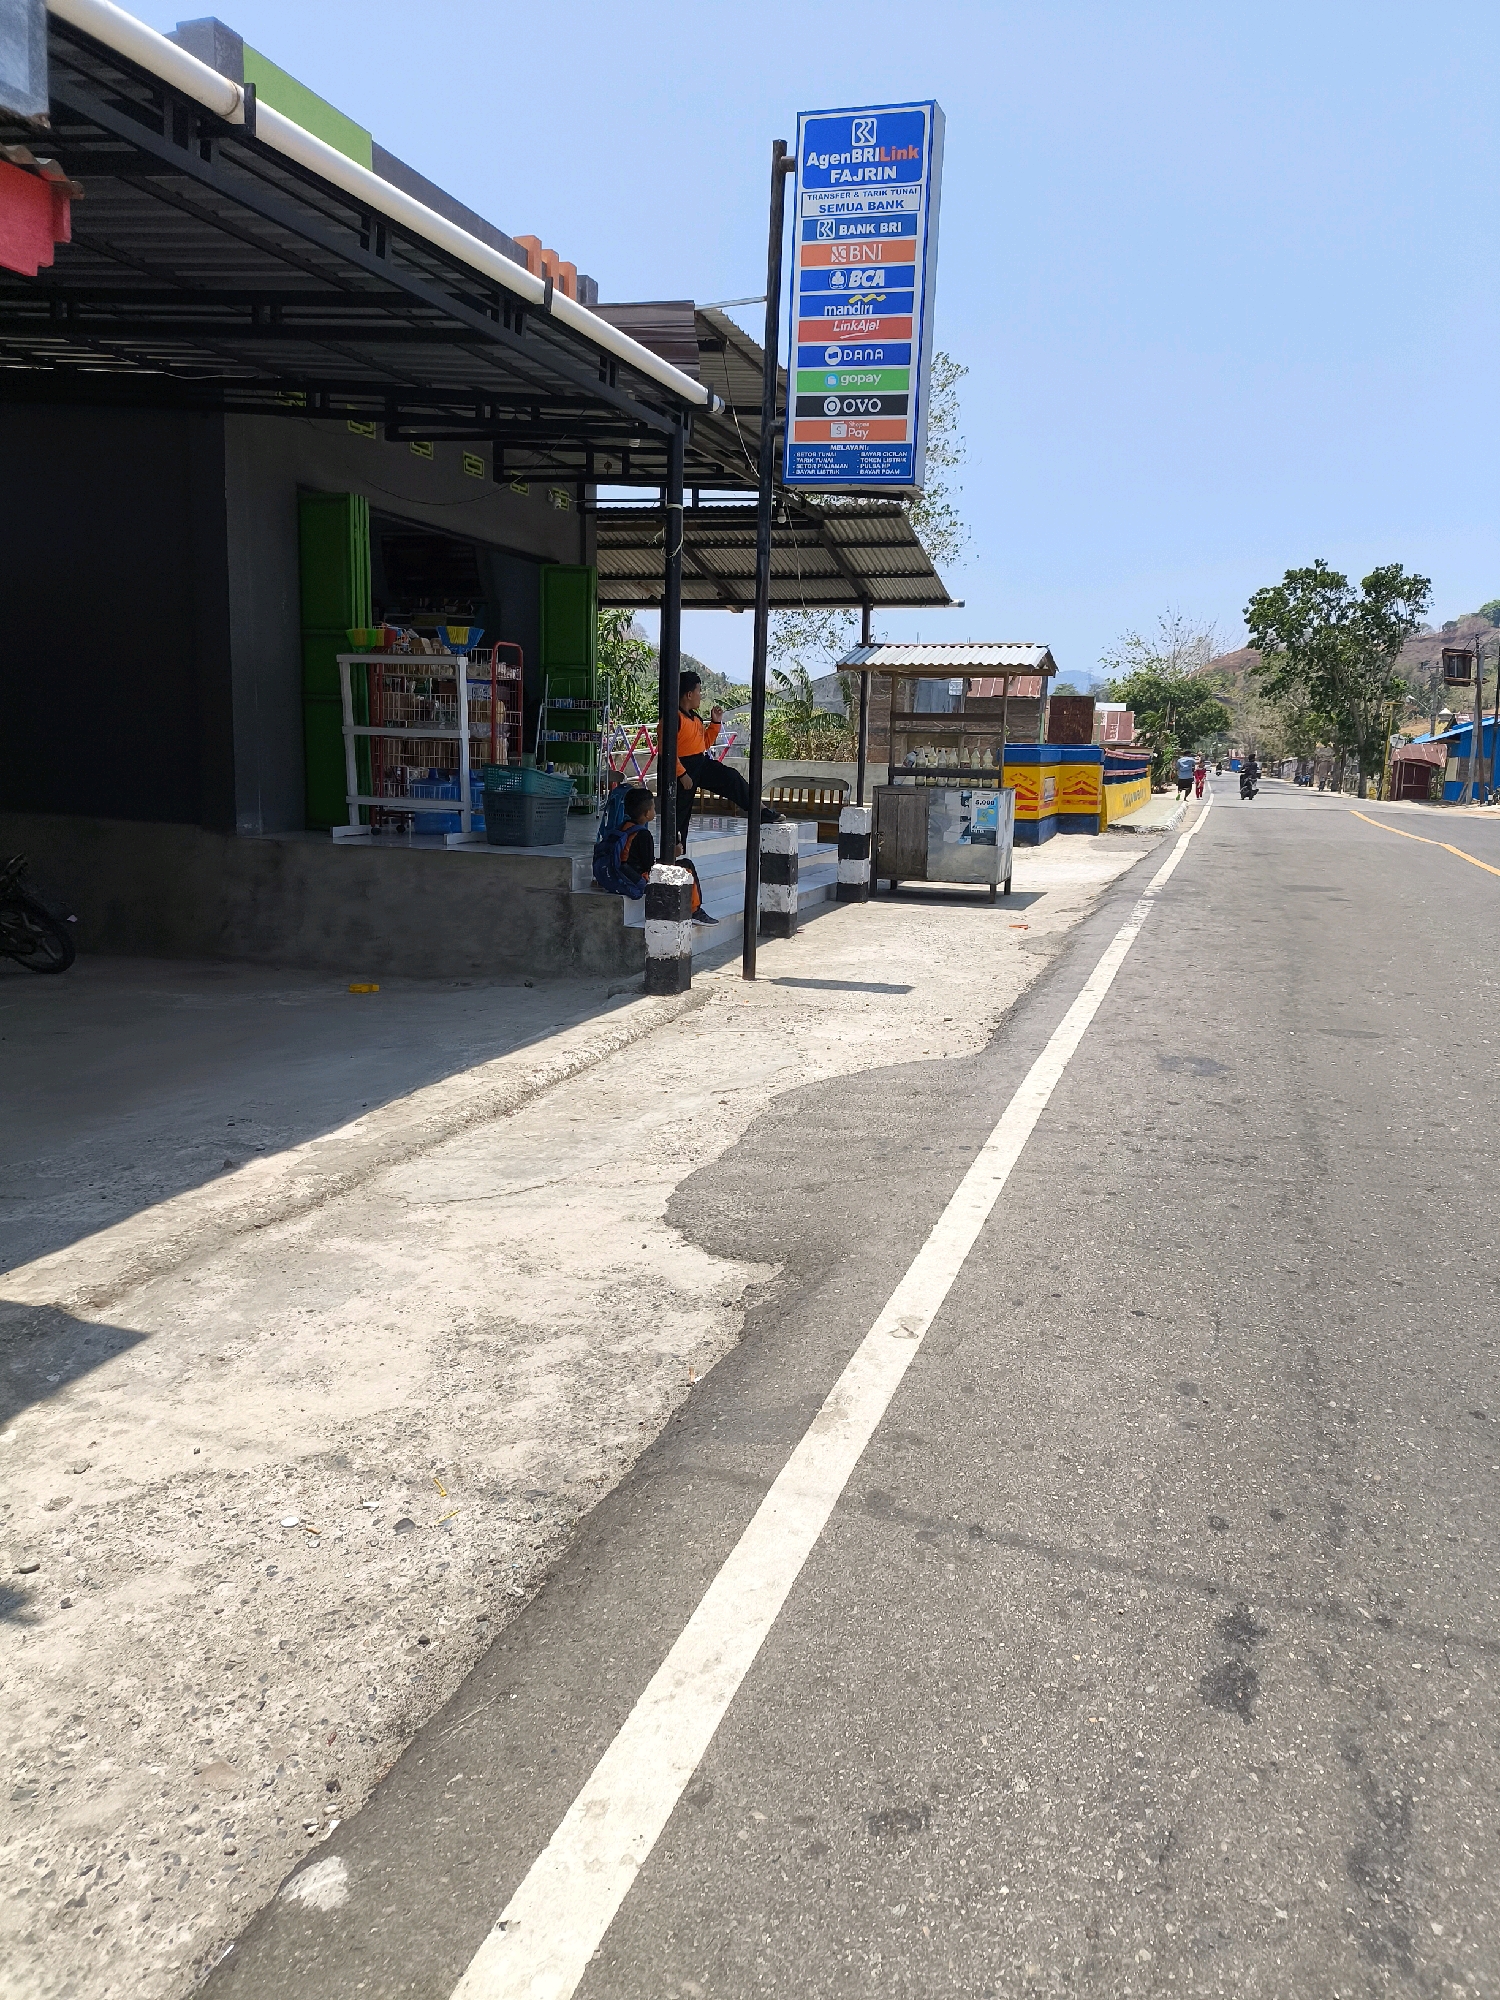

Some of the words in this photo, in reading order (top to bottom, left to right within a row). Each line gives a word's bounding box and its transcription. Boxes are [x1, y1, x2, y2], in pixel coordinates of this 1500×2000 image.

[806, 145, 919, 169] AgenBRILink
[830, 166, 897, 183] FAJRIN
[807, 192, 851, 201] TRANSFER
[863, 190, 888, 198] TARIK
[891, 188, 917, 196] TUNAI
[819, 201, 864, 214] SEMUA
[868, 200, 905, 211] BANK
[839, 223, 875, 236] BANK
[880, 222, 902, 234] BRI
[849, 244, 883, 261] BNI
[848, 270, 885, 288] BCA
[824, 302, 873, 316] mandiri
[833, 320, 880, 333] LinkAja!
[844, 349, 884, 361] DANA
[841, 373, 882, 385] gopay
[843, 398, 882, 413] OVO
[848, 427, 869, 440] Pay
